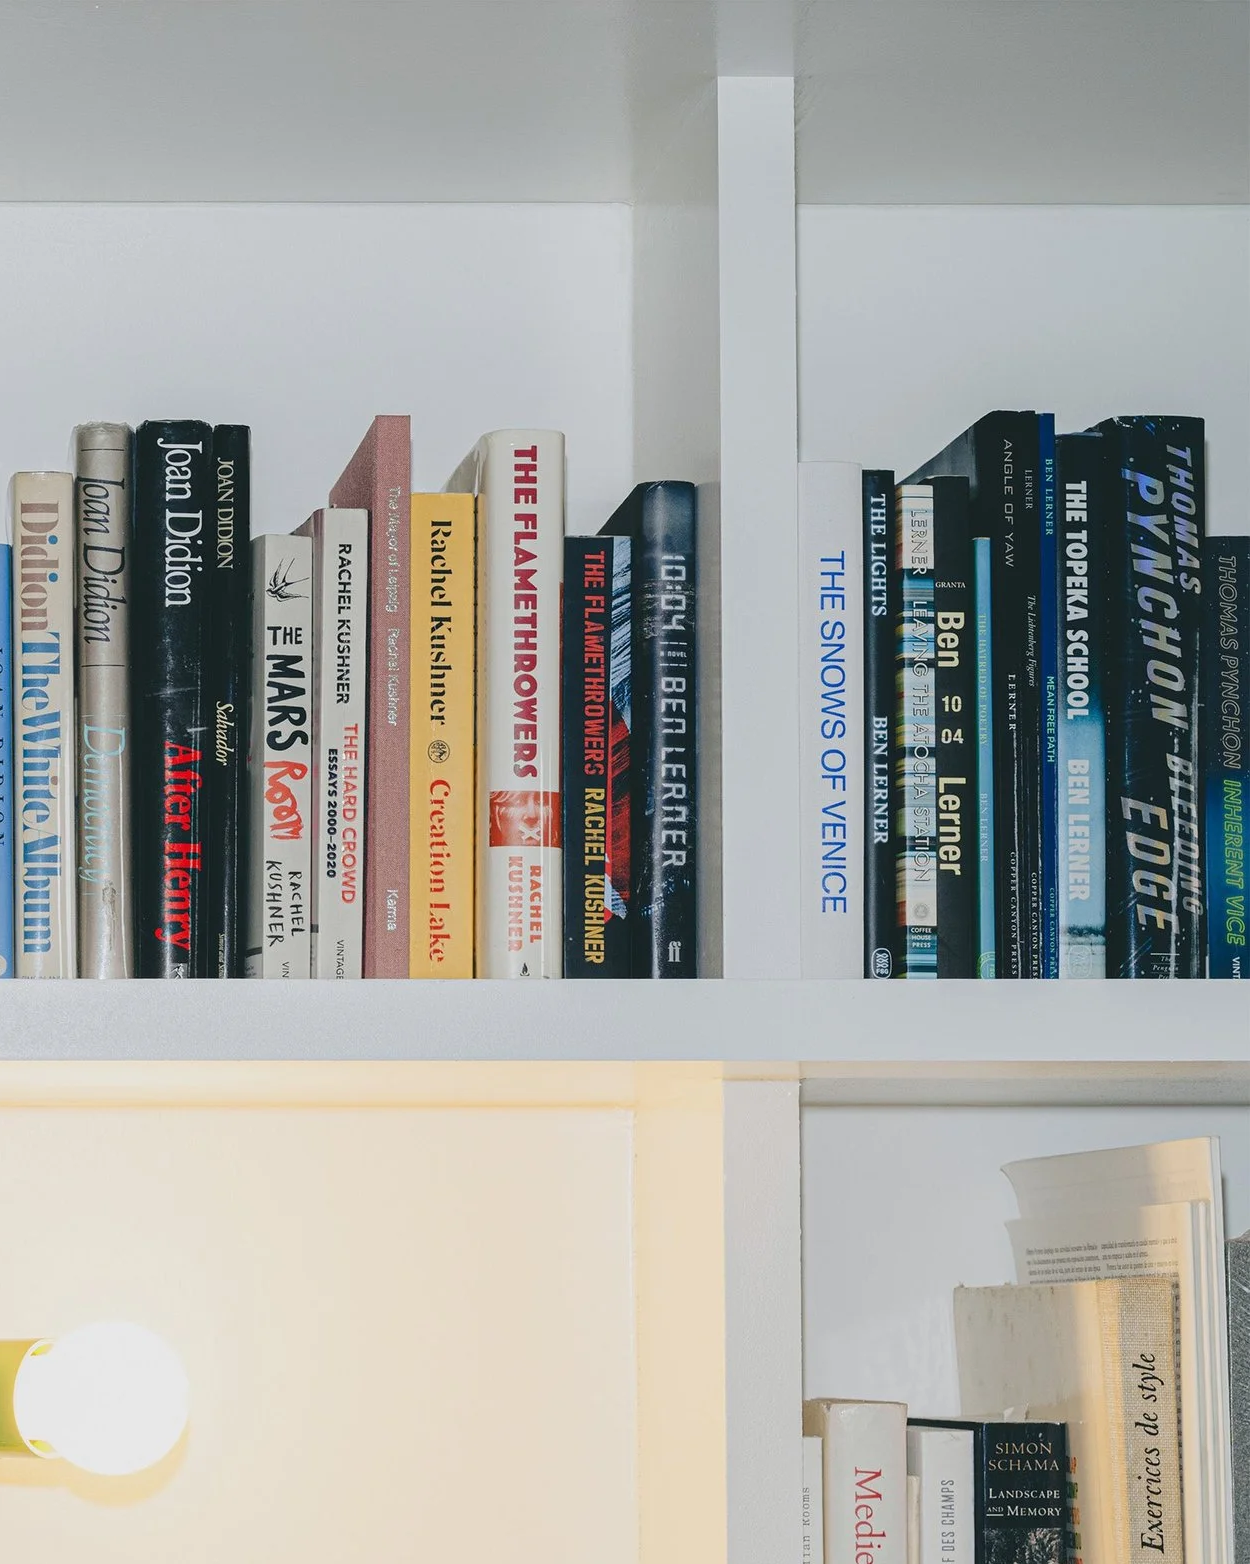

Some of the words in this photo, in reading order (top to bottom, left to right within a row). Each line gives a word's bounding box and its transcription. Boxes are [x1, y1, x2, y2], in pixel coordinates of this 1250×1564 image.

[157, 438, 202, 505] Joan
[514, 446, 537, 504] THE
[1004, 440, 1013, 494] ANGLE
[871, 494, 886, 535] THE
[1005, 504, 1013, 528] OF
[1066, 481, 1087, 522] THE
[165, 509, 202, 607] Didion
[431, 521, 452, 606] Rachel
[871, 542, 886, 615] LIGHTS
[1005, 533, 1013, 566] YAW
[1066, 530, 1088, 621] TOPEKA
[821, 551, 844, 610] THE
[431, 616, 452, 725] Kushner
[514, 514, 537, 777] FLAMETHROWERS
[1066, 629, 1088, 719] SCHOOL
[821, 621, 846, 739] SNOWS
[1047, 676, 1055, 705] MEAN
[873, 716, 887, 755] BEN
[1047, 709, 1055, 734] FREE
[165, 740, 201, 824] After
[821, 749, 846, 795] OF
[1066, 760, 1090, 808] BEN
[873, 764, 888, 844] LERNER
[430, 780, 450, 892] Creation
[822, 801, 846, 913] VENICE
[1064, 813, 1089, 901] LERNER
[155, 839, 200, 949] Henry
[430, 903, 450, 962] Lake
[1132, 1354, 1160, 1402] style
[996, 1443, 1051, 1454] SIMON
[1139, 1413, 1158, 1436] de
[989, 1460, 1059, 1470] SCHAMA
[989, 1488, 1059, 1498] LANDSCAPE
[1138, 1448, 1164, 1554] Exercices
